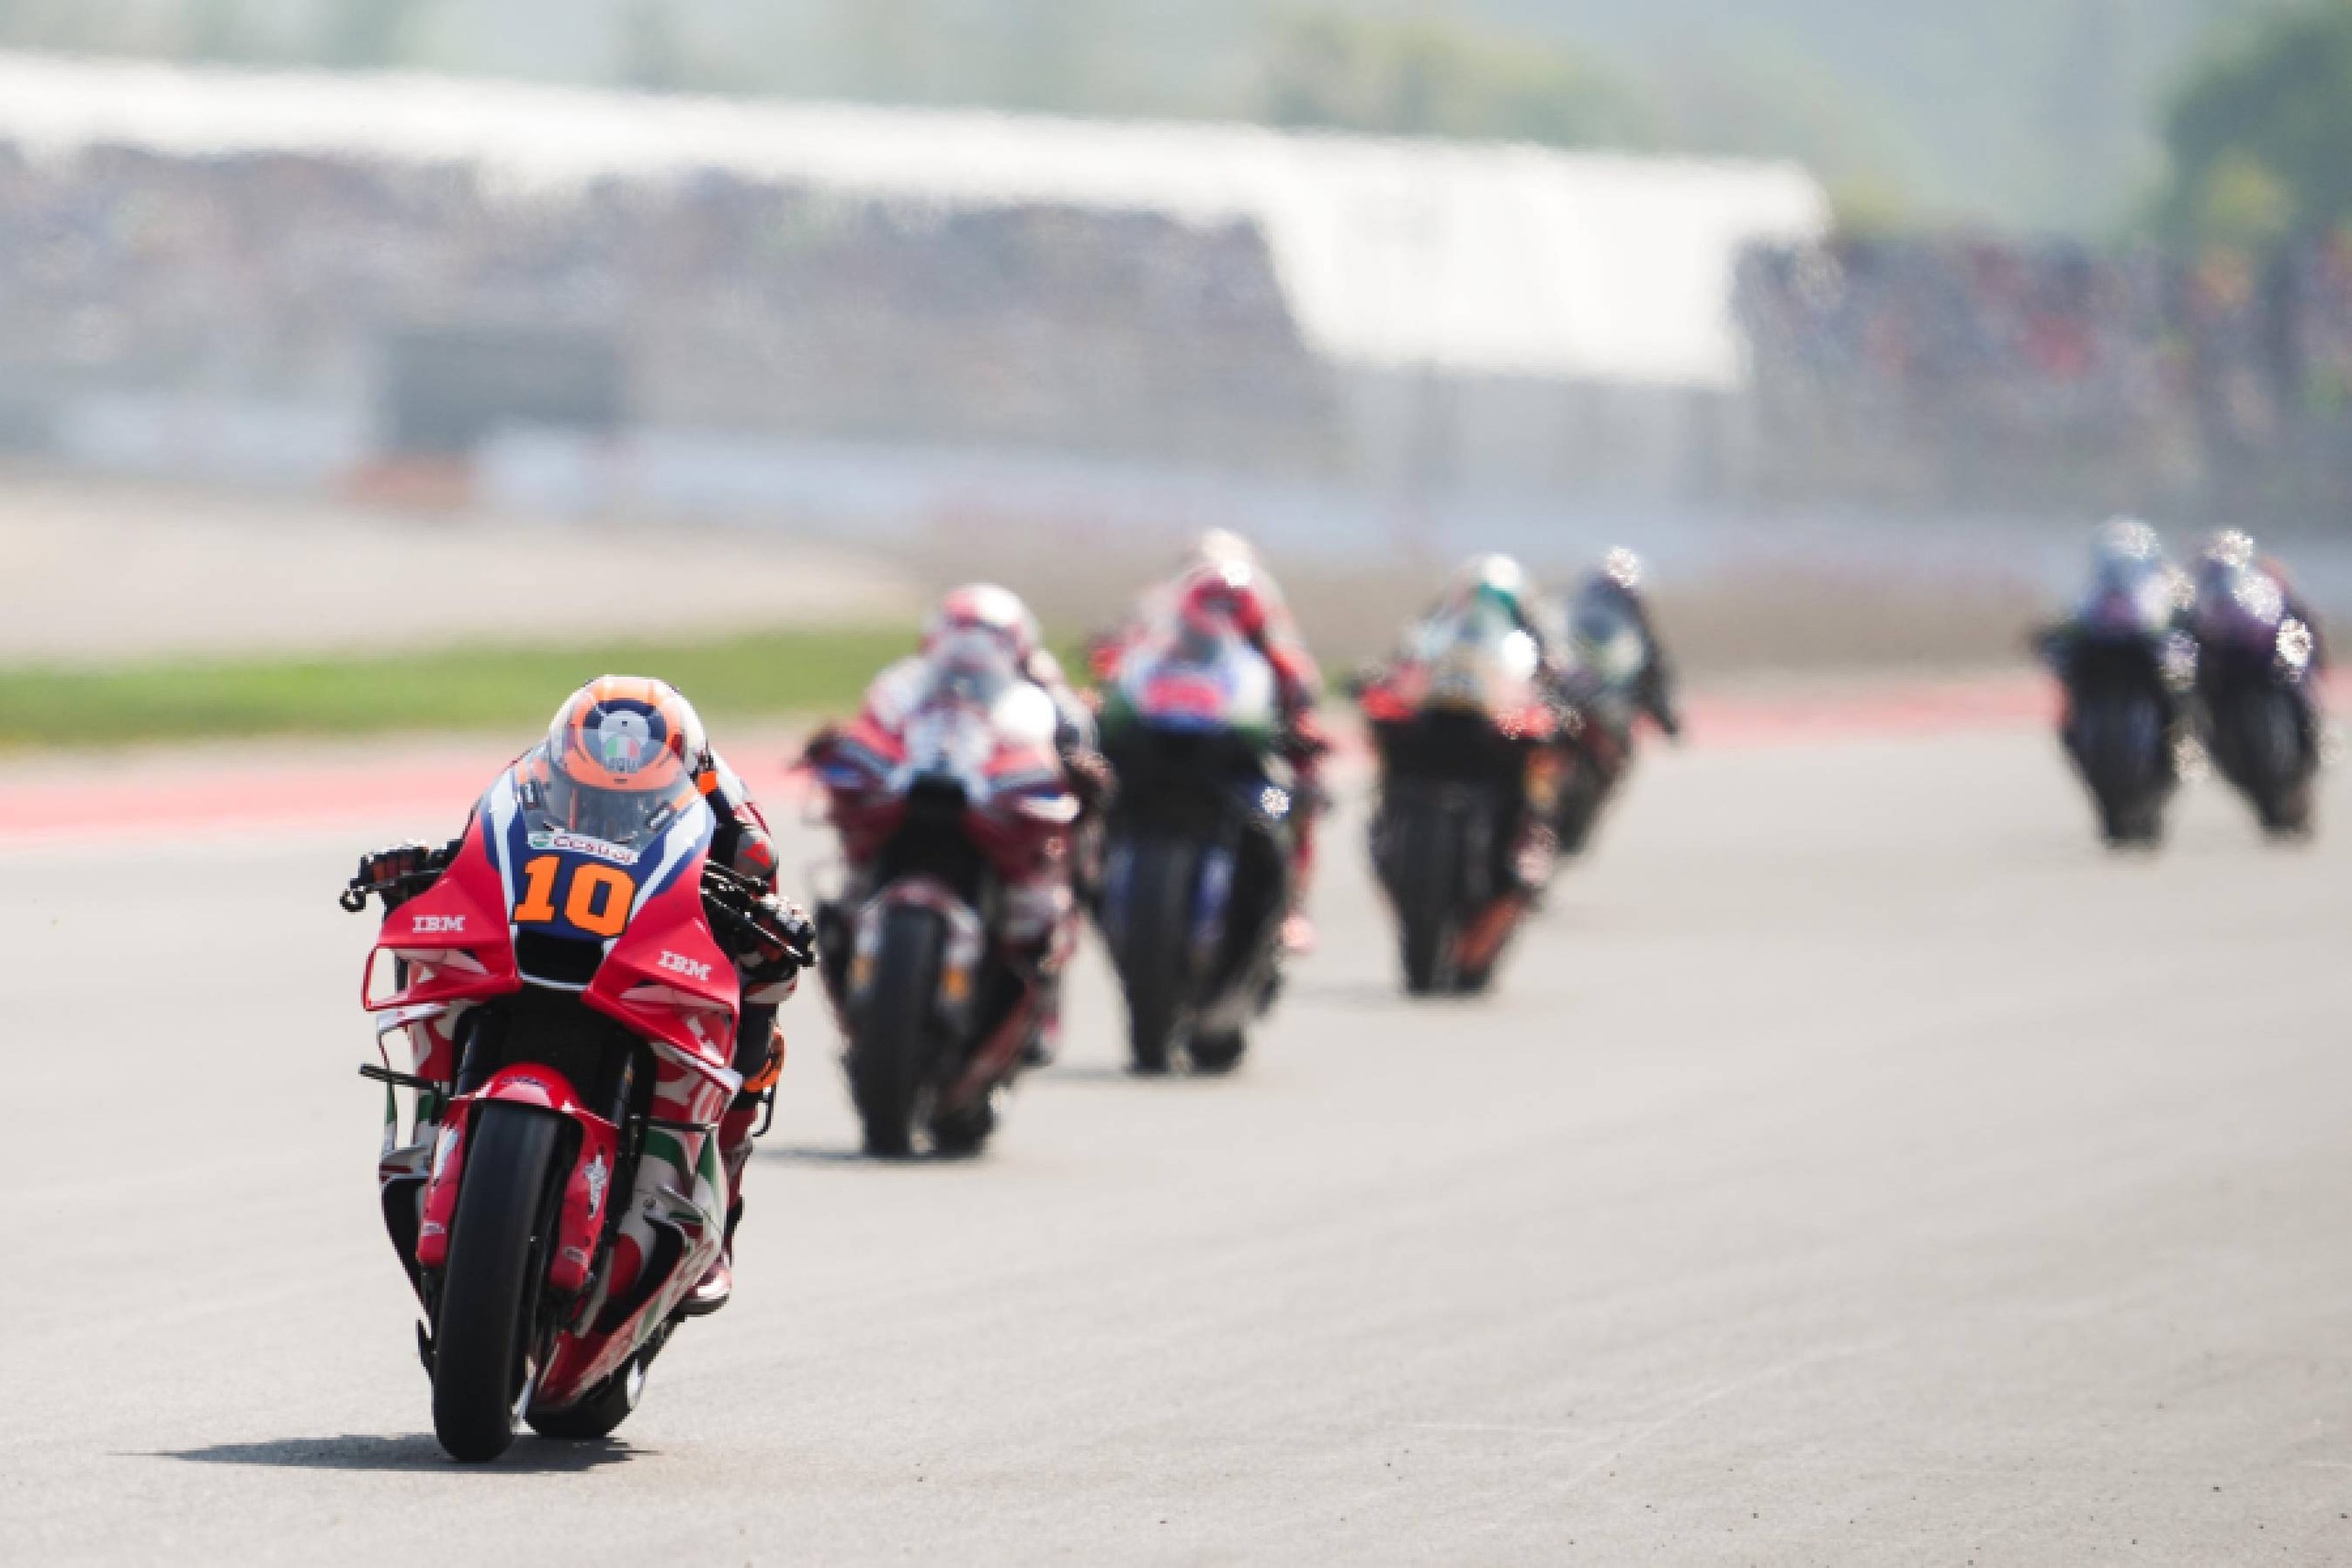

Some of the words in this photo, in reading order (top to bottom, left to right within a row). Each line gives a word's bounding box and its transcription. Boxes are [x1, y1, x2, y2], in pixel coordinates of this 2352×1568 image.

[514, 855, 636, 936] 10
[413, 915, 465, 933] IBM
[658, 951, 711, 982] IBM
